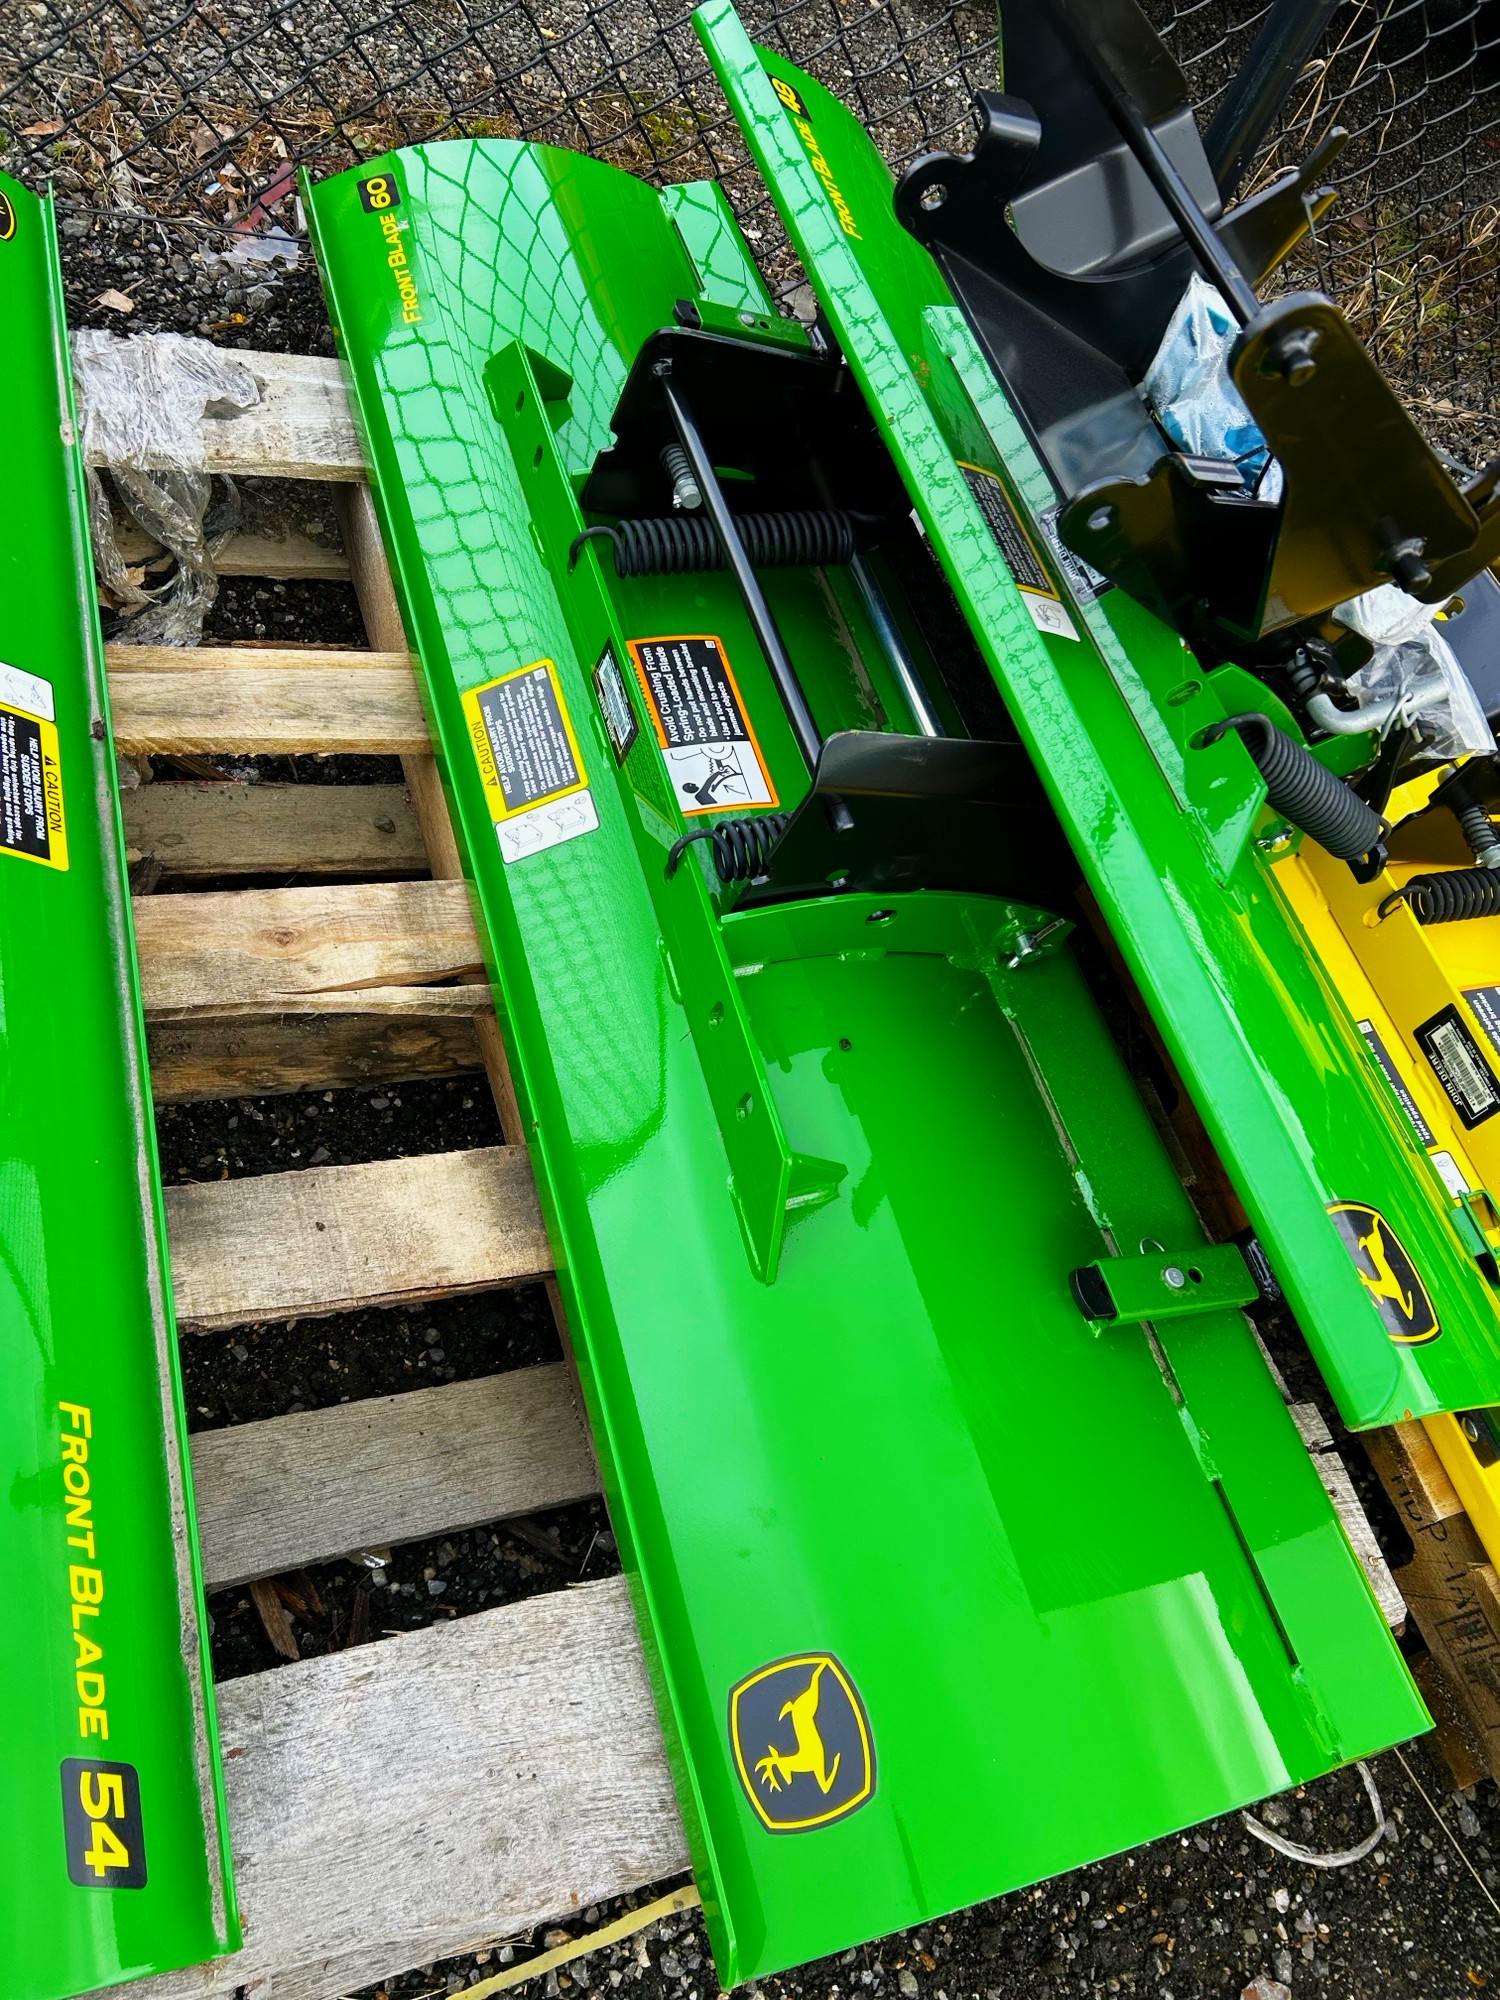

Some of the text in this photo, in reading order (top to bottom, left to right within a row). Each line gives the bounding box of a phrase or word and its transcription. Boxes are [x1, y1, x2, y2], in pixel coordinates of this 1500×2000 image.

[793, 117, 833, 179] BLADE
[821, 176, 863, 240] FRONT
[366, 177, 423, 324] FRONT BLADE 60
[1062, 559, 1080, 582] JOHN
[642, 647, 656, 670] From
[679, 643, 718, 736] blade and mounting bracket
[701, 666, 715, 691] remove
[651, 672, 670, 714] Crushing
[655, 646, 694, 741] Spring-Loaded Blade
[672, 649, 707, 737] Do not put hands between
[501, 701, 510, 721] except
[543, 708, 552, 725] blade
[712, 701, 723, 715] tool
[717, 681, 743, 735] jammed objects
[6, 719, 15, 736] Keep
[506, 721, 518, 748] unlocked
[548, 726, 559, 748] scraper
[663, 716, 680, 742] Avoid
[721, 722, 730, 735] Use
[0, 733, 9, 754] speed
[8, 737, 16, 758] spring
[471, 721, 493, 774] CAUTION
[482, 705, 512, 794] HELP AVOID INJURY FROM
[495, 719, 515, 773] SUDDEN STOPS
[557, 731, 574, 779] speed operation
[10, 759, 18, 772] trip
[517, 760, 527, 780] spring
[555, 749, 564, 768] rubber
[2, 775, 11, 801] digging
[11, 773, 20, 804] unlocked
[20, 754, 34, 815] SUDDEN STOPS
[29, 737, 45, 840] HELP AVOID INJURY FROM
[5, 802, 13, 816] and
[46, 771, 61, 832] CAUTION
[4, 816, 15, 844] grading
[13, 805, 22, 828] except
[1473, 999, 1494, 1030] between
[1476, 992, 1497, 1019] bracket
[1429, 1053, 1448, 1081] DEERE
[1445, 1082, 1462, 1105] JOHN
[1399, 1089, 1430, 1139] speed operation
[58, 1400, 130, 1877] FRONT BLADE 54
